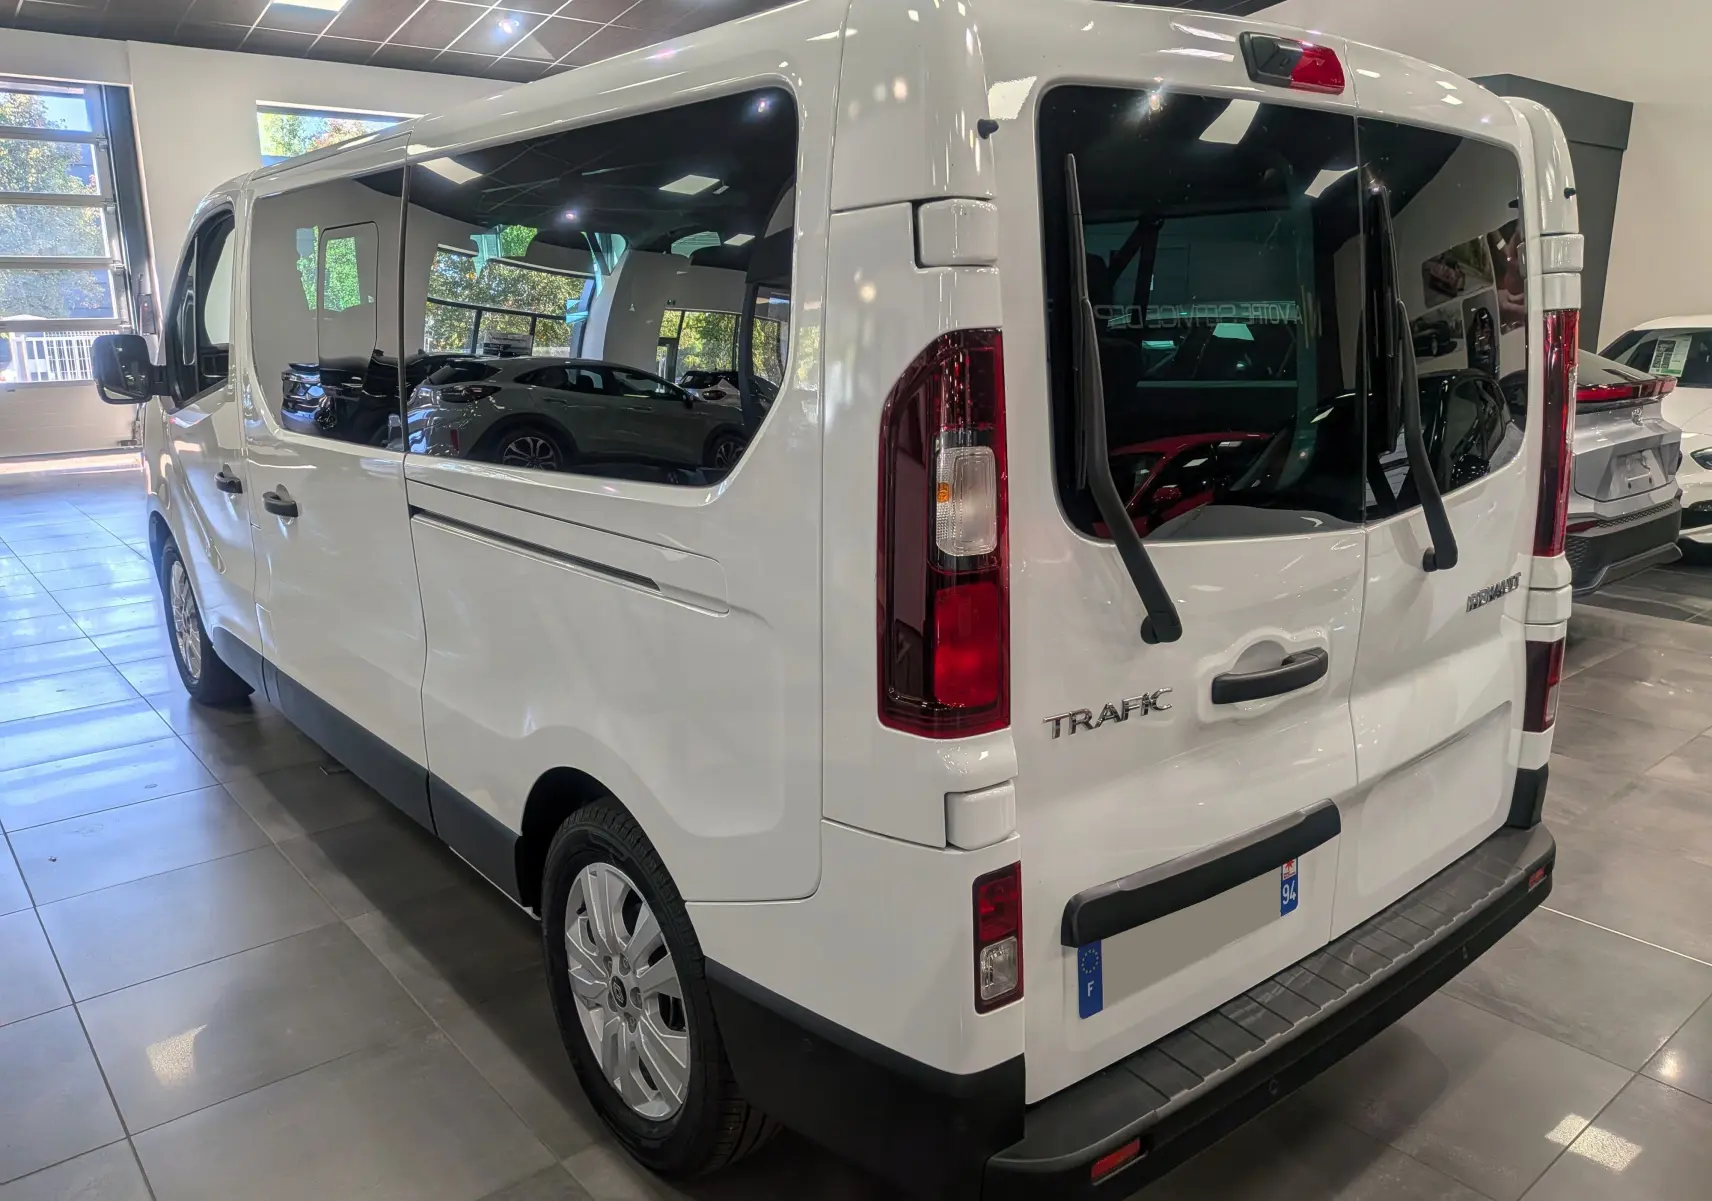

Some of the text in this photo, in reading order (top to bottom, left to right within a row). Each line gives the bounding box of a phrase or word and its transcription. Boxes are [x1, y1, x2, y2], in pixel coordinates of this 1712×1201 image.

[1466, 571, 1521, 612] RENAULT
[1042, 687, 1173, 739] TRAFIC
[1282, 879, 1297, 905] 94
[1087, 980, 1095, 997] F
